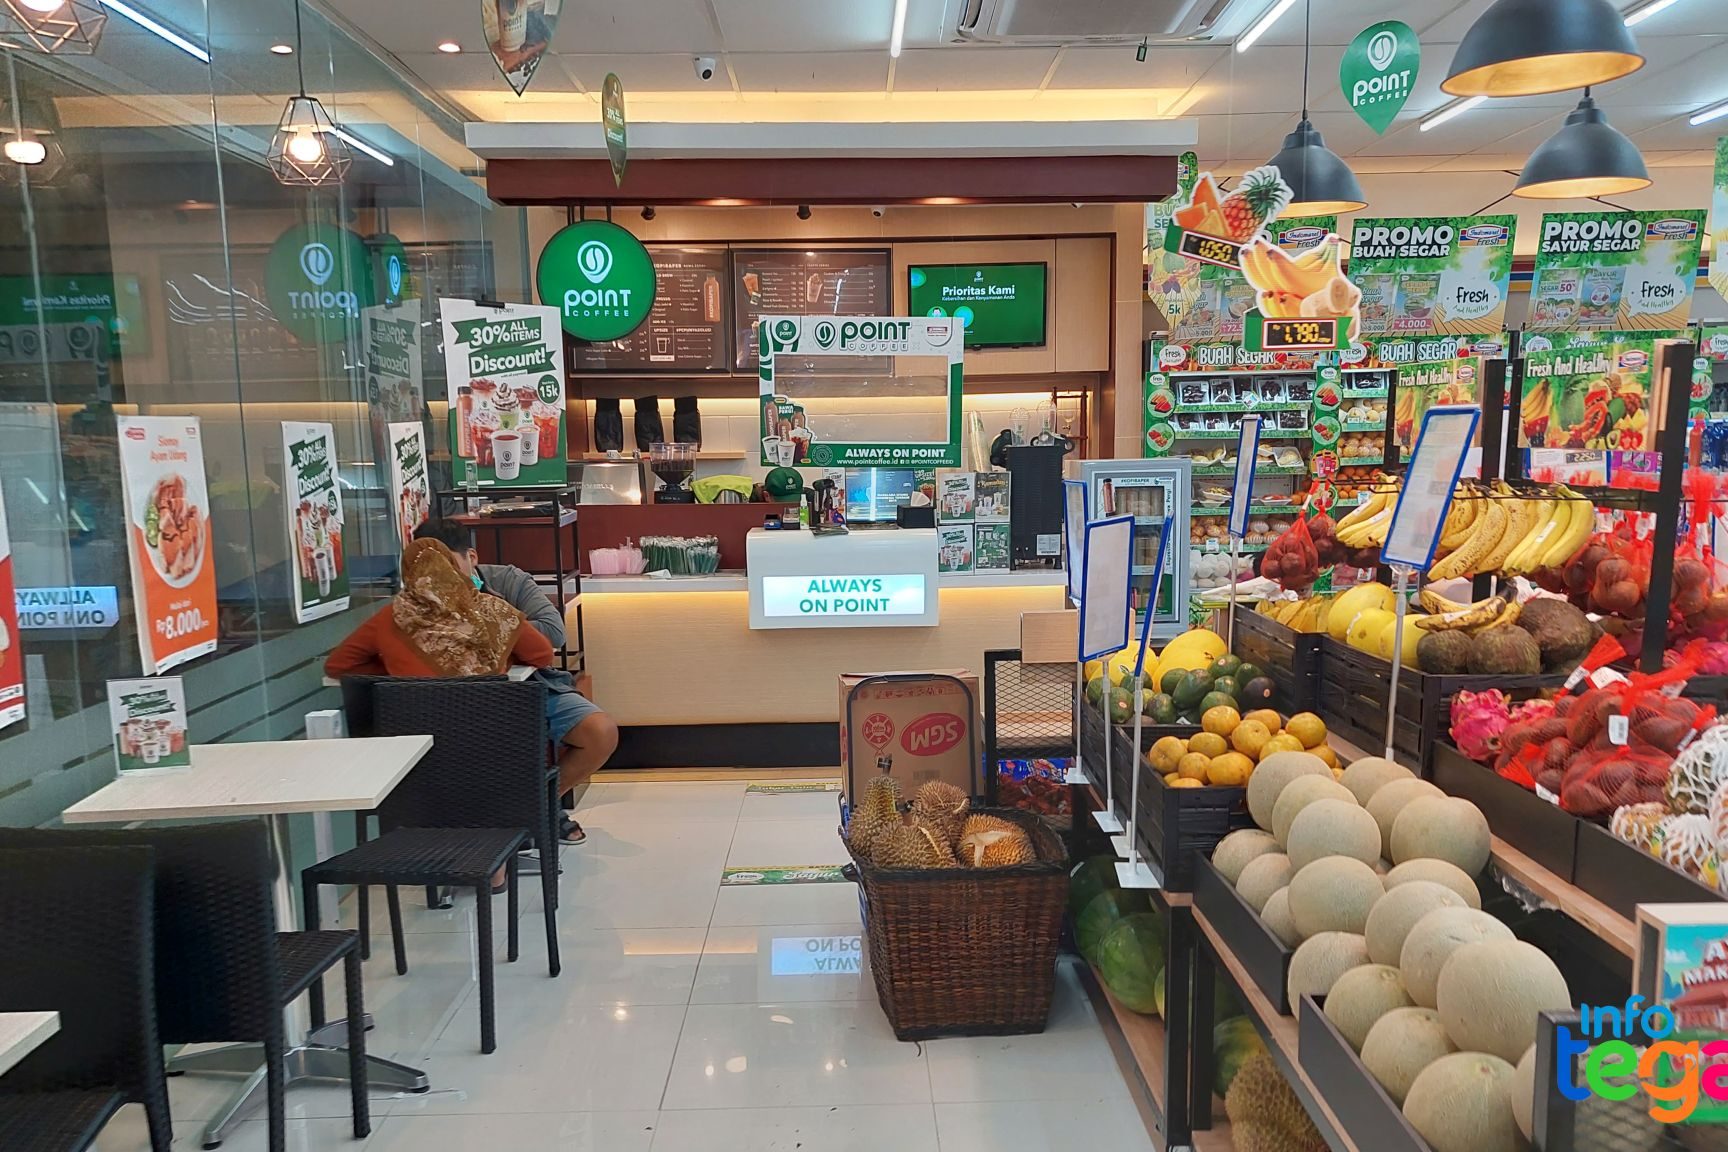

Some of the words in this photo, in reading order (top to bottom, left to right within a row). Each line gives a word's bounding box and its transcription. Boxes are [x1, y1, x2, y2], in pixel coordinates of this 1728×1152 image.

[1359, 90, 1408, 105] COFFEE
[1287, 231, 1320, 239] Indomaret
[1354, 225, 1454, 246] PROMO
[1468, 229, 1501, 237] Indomaret
[1543, 219, 1642, 241] PROMO
[1655, 223, 1689, 232] Indomaret
[1663, 232, 1688, 241] Fresh
[1476, 237, 1501, 246] Fresh
[1542, 240, 1590, 253] SAYUR
[1593, 239, 1641, 252] SEGAR
[1352, 246, 1399, 258] BUAH
[1399, 245, 1451, 257] SEGAR
[942, 286, 986, 296] Prioritas
[988, 284, 1015, 295] Kami
[1398, 320, 1426, 328] 4.000
[470, 325, 511, 347] 30%
[510, 320, 529, 332] ALL
[511, 327, 540, 342] ITEMS
[847, 342, 908, 350] COFFEE
[1380, 341, 1416, 362] BUAH
[1417, 341, 1458, 362] SEGAR
[471, 347, 546, 374] Discount!
[1199, 345, 1234, 366] BUAH
[1236, 348, 1275, 366] SEGAR
[1527, 358, 1552, 377] Fresh
[1554, 356, 1573, 376] And
[1399, 370, 1416, 386] Fresh
[1416, 369, 1429, 386] And
[540, 385, 559, 398] 15k
[845, 448, 891, 458] ALWAYS
[892, 448, 910, 458] ON
[911, 448, 946, 458] POINT
[836, 458, 899, 466] www.pointcoffee.id
[807, 578, 882, 593] ALWAYS
[799, 599, 828, 613] ON
[833, 598, 890, 613] POINT
[910, 721, 958, 751] SGM
